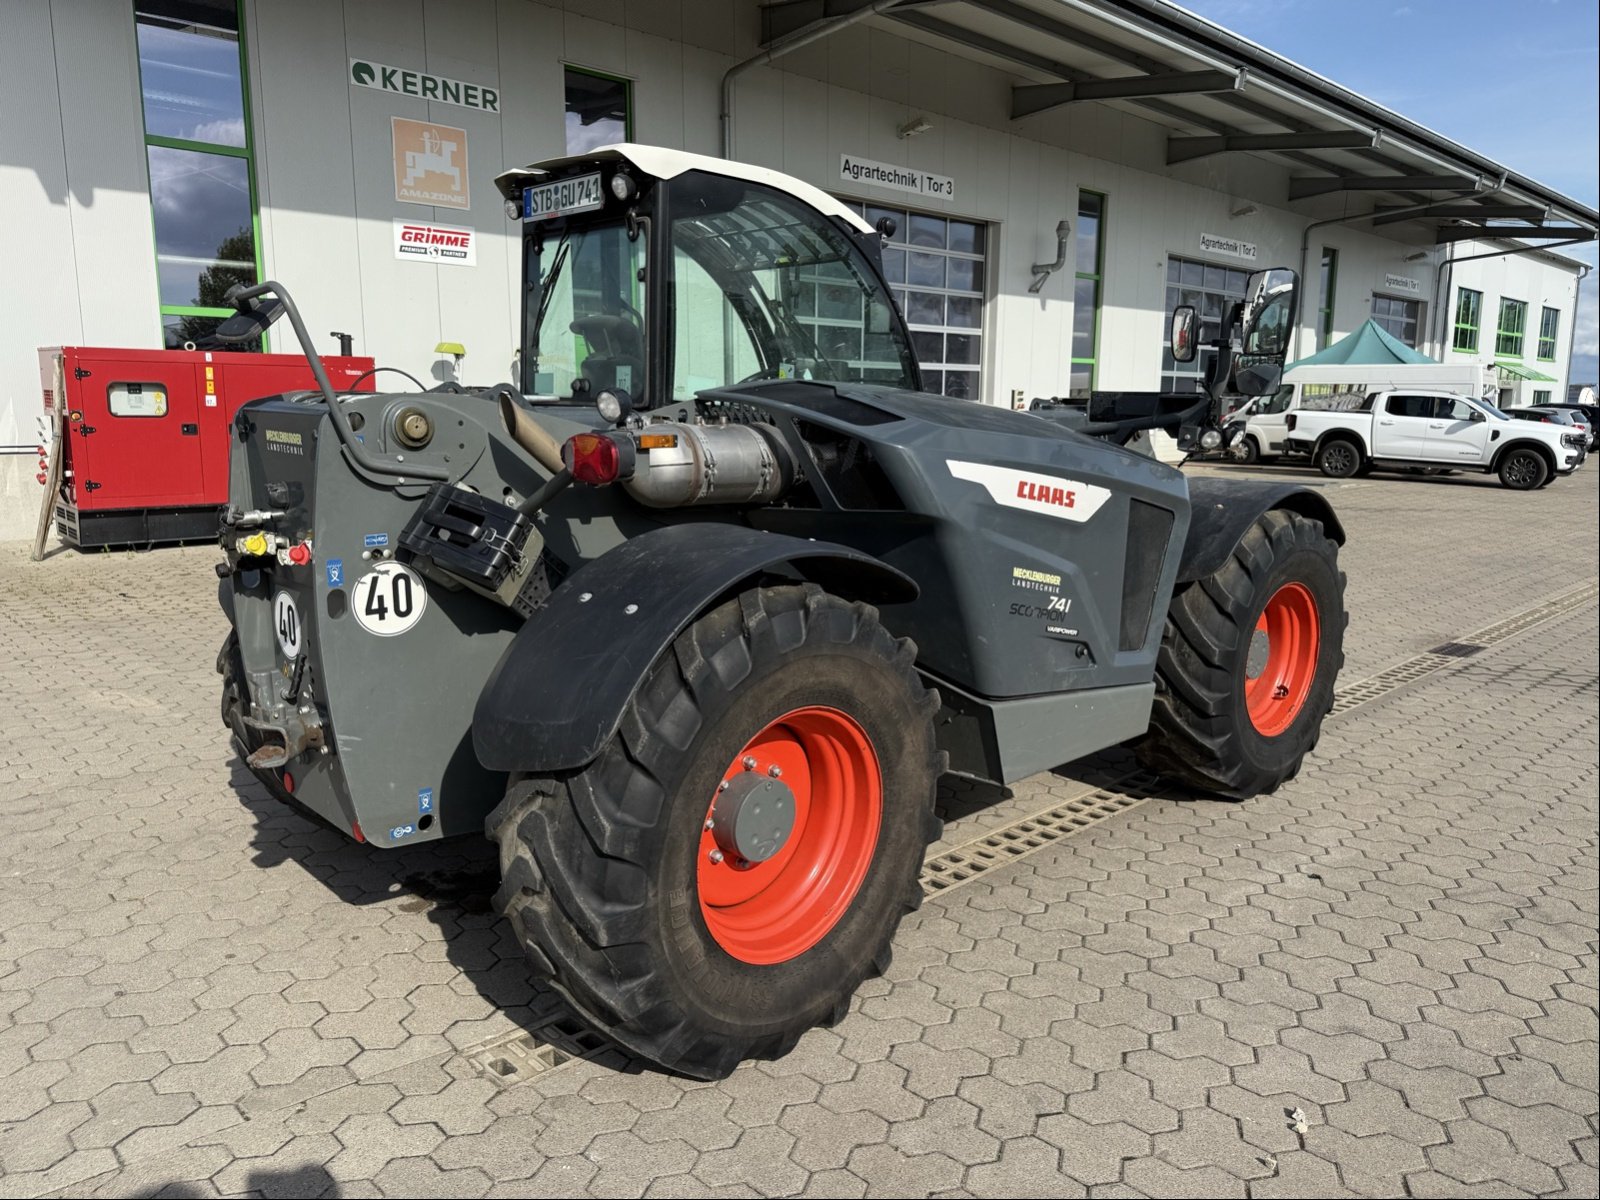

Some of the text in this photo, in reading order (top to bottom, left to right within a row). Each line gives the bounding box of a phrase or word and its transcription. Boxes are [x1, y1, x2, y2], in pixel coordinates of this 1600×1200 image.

[381, 66, 498, 112] KERNER
[842, 158, 917, 188] Agrartechnik
[926, 176, 944, 193] Tor
[946, 181, 953, 195] 3
[400, 188, 466, 204] AMAZONE
[532, 177, 600, 214] STB GU 741
[401, 227, 470, 248] GRIMME
[1201, 236, 1238, 253] Agrartechnik
[1243, 244, 1251, 256] Tor
[1252, 246, 1256, 257] 2
[401, 246, 466, 258] PREMIUM PARTNER
[265, 429, 303, 446] MECKLENBURGER
[266, 442, 304, 456] LANDTECHNIK
[1016, 480, 1076, 509] CLAAS
[1011, 578, 1060, 594] LANDTECHNIK
[1012, 566, 1062, 586] MECKLENBURGER
[364, 572, 413, 621] 40
[1047, 595, 1072, 613] 741
[1009, 602, 1067, 623] SCORPION
[278, 601, 297, 646] 40
[1047, 625, 1078, 636] VARIPOWER
